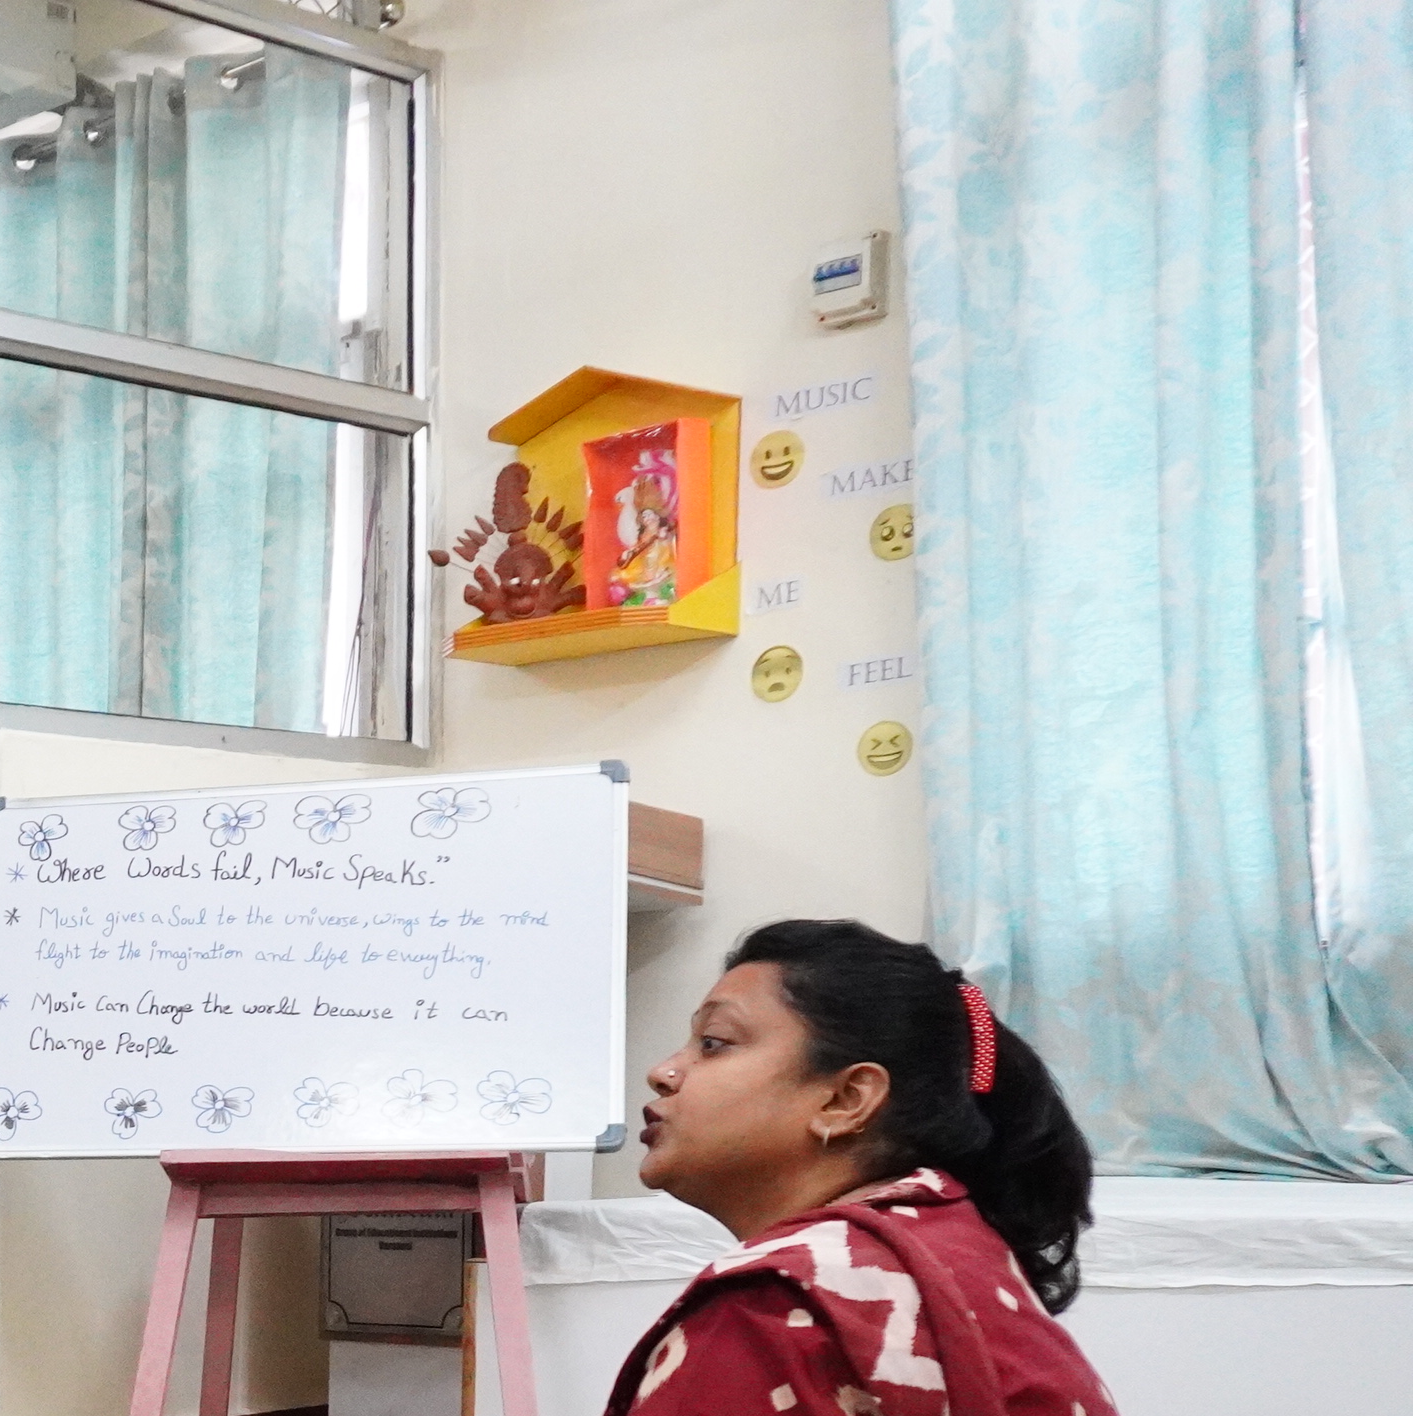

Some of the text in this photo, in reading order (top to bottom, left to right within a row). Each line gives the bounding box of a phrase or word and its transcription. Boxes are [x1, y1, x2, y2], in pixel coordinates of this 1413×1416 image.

[775, 377, 872, 417] MUSIC
[831, 459, 914, 496] MAKE
[757, 580, 799, 609] ME
[848, 657, 913, 686] FEEL
[37, 857, 107, 883] Where
[127, 855, 201, 879] Words
[211, 850, 262, 885] fail,
[271, 856, 335, 880] Music
[39, 906, 95, 929] Music
[102, 909, 146, 937] gives
[152, 914, 164, 925] a
[168, 905, 207, 926] Soul
[218, 905, 237, 925] to
[247, 905, 274, 925] the
[430, 909, 450, 927] to
[459, 908, 485, 926] the
[499, 910, 549, 927] mind
[35, 939, 81, 969] flight
[89, 941, 109, 959] to
[118, 940, 141, 959] the
[149, 940, 243, 970] imagination
[255, 945, 295, 962] and
[361, 943, 382, 963] to
[31, 992, 85, 1014] Music
[203, 992, 233, 1014] the
[242, 996, 300, 1016] world
[313, 996, 394, 1019] because
[414, 999, 439, 1020] it
[462, 1006, 508, 1021] can
[30, 1027, 106, 1060] Change
